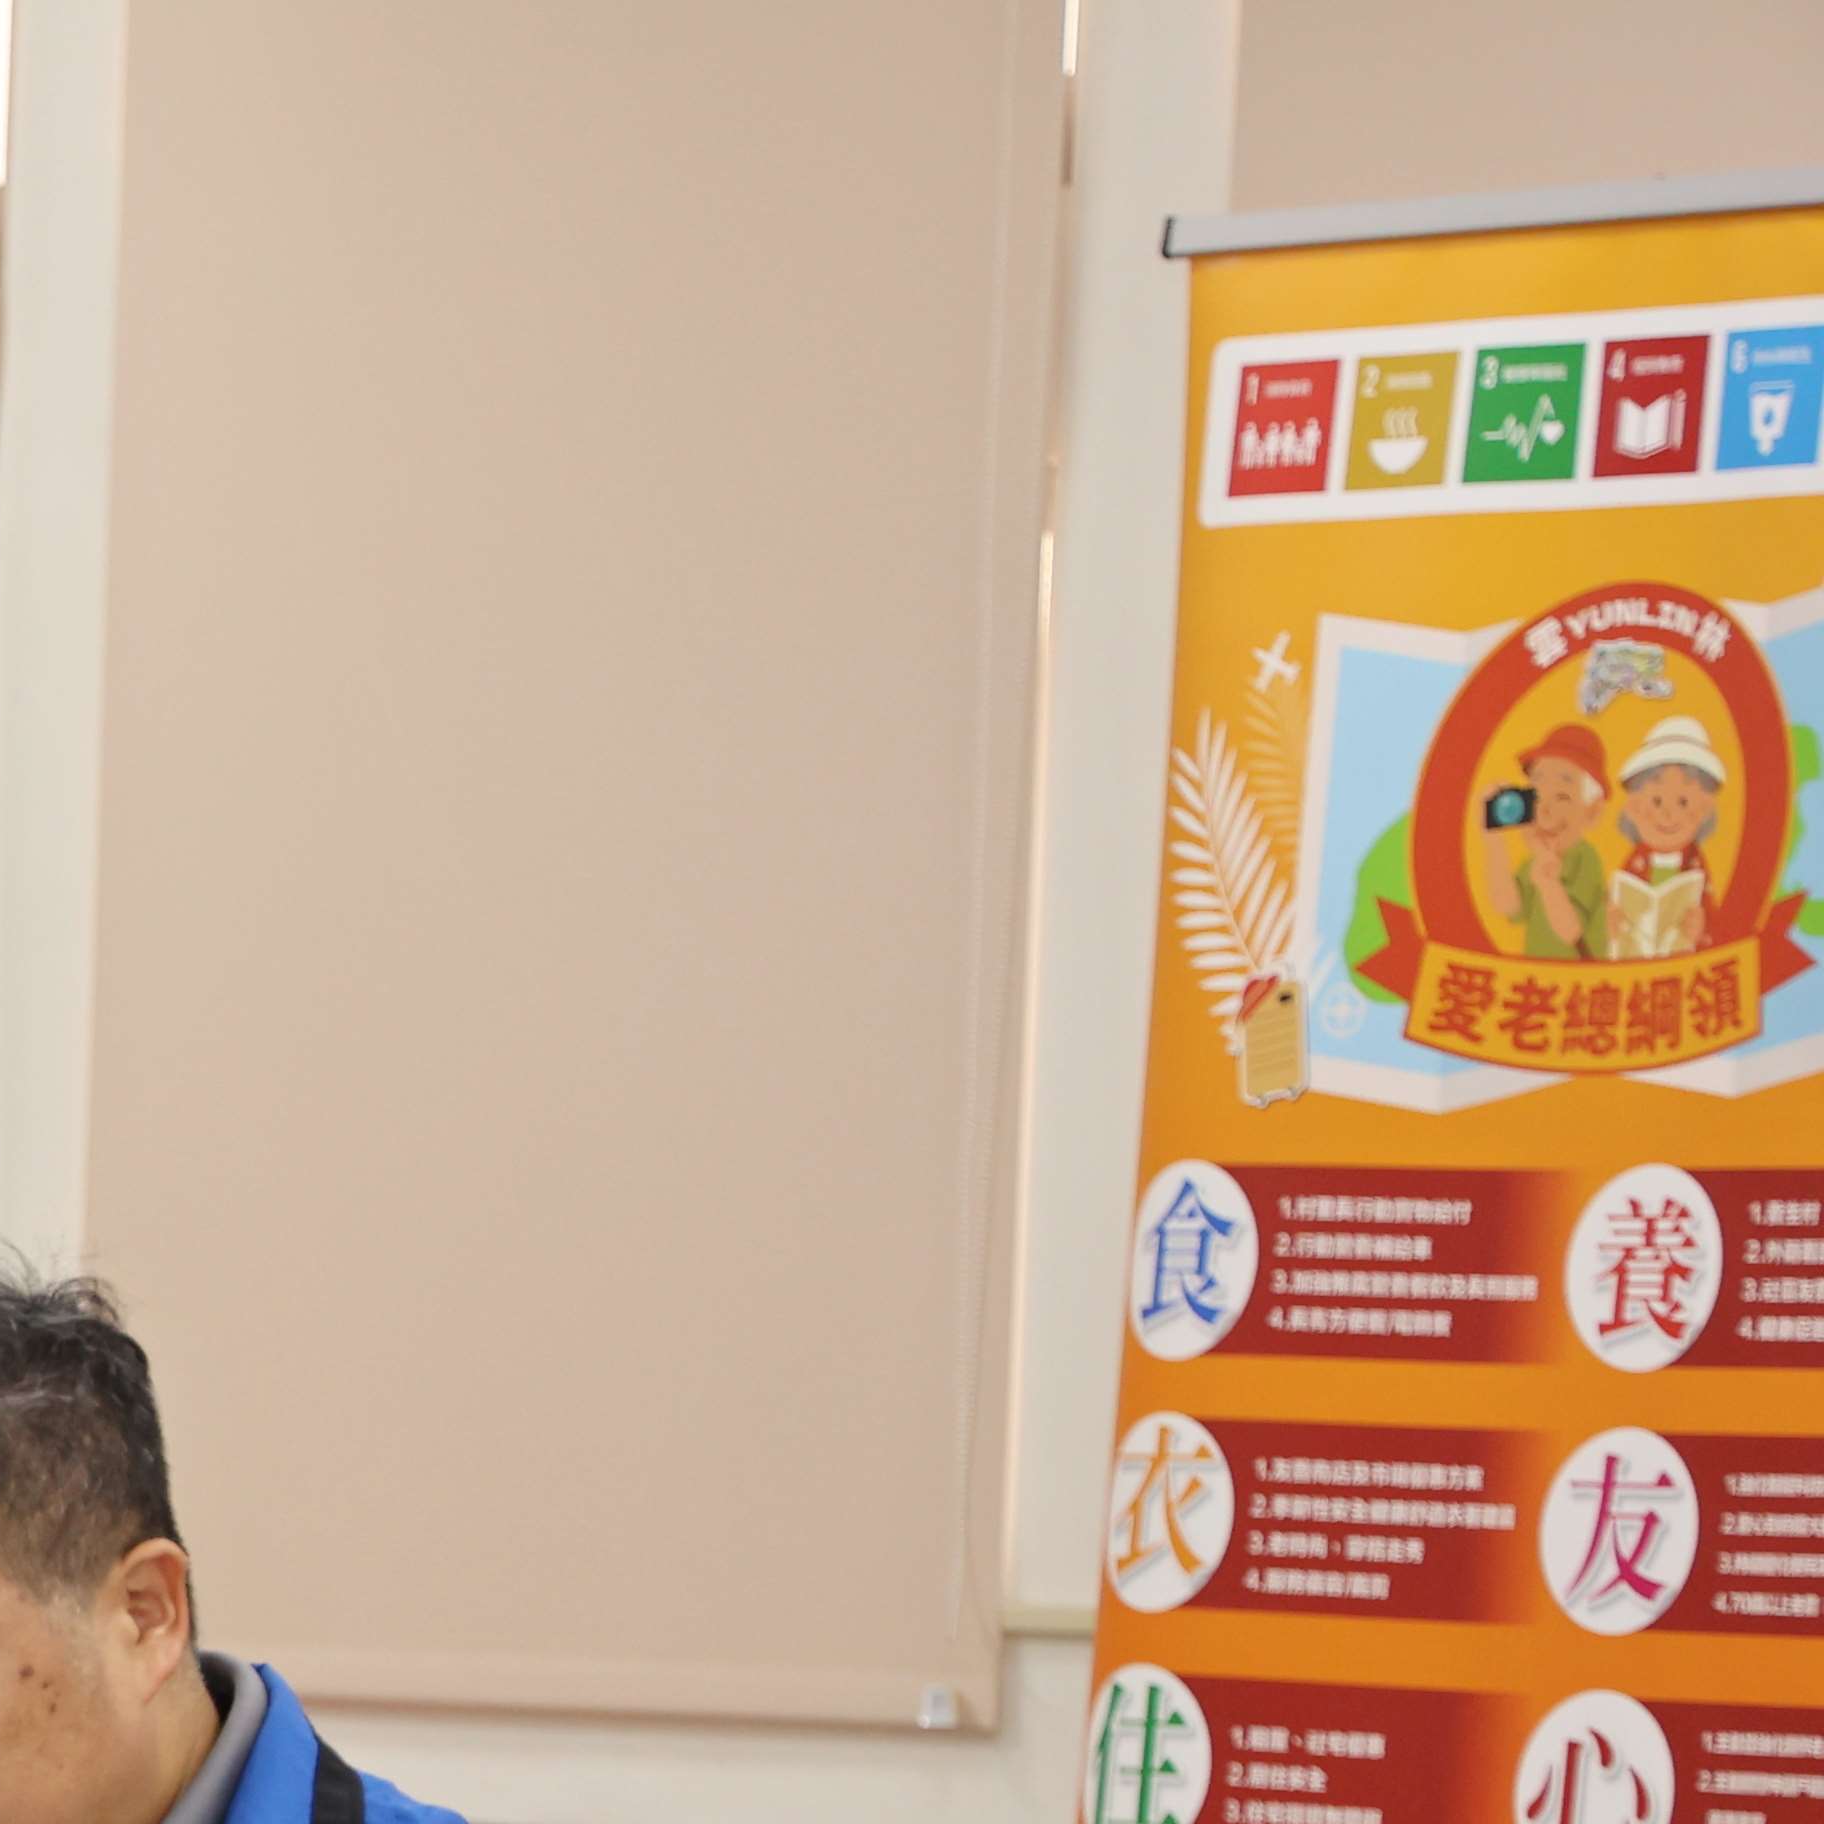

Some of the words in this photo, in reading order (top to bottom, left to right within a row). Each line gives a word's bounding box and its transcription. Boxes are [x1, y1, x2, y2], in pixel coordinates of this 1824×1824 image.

[1428, 957, 1745, 1057] 愛老總綱領
[1140, 1177, 1236, 1326] 食
[1597, 1196, 1697, 1344] 養
[1116, 1425, 1215, 1578] 衣
[1565, 1452, 1674, 1605] 友
